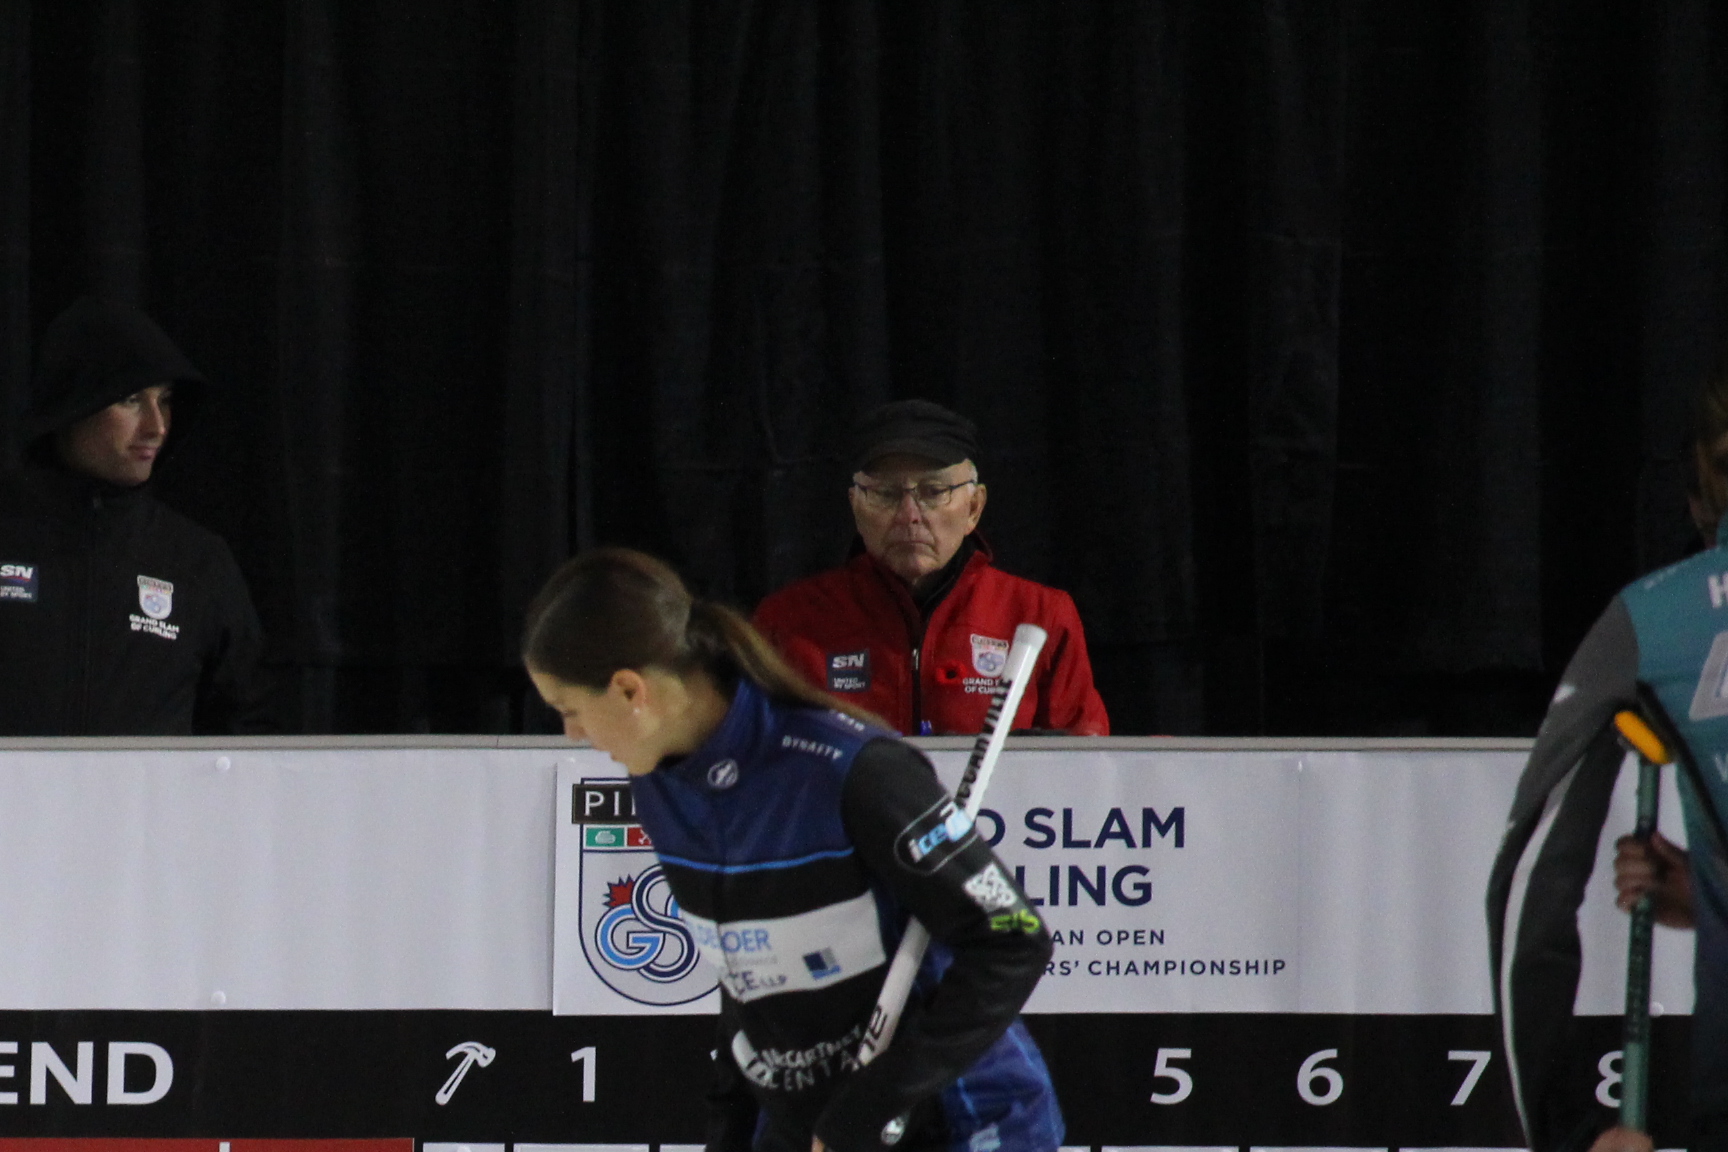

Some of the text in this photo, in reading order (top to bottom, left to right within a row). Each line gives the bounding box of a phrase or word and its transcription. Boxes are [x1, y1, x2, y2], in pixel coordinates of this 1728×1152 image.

[0, 564, 33, 579] SN
[832, 653, 865, 668] SN
[1023, 807, 1186, 849] SLAM
[1096, 929, 1166, 947] OPEN
[1087, 959, 1287, 977] CHAMPIONSHIP
[570, 1045, 598, 1103] 1
[1149, 1047, 1194, 1105] 5
[1296, 1048, 1345, 1107] 6
[1447, 1050, 1493, 1107] 7
